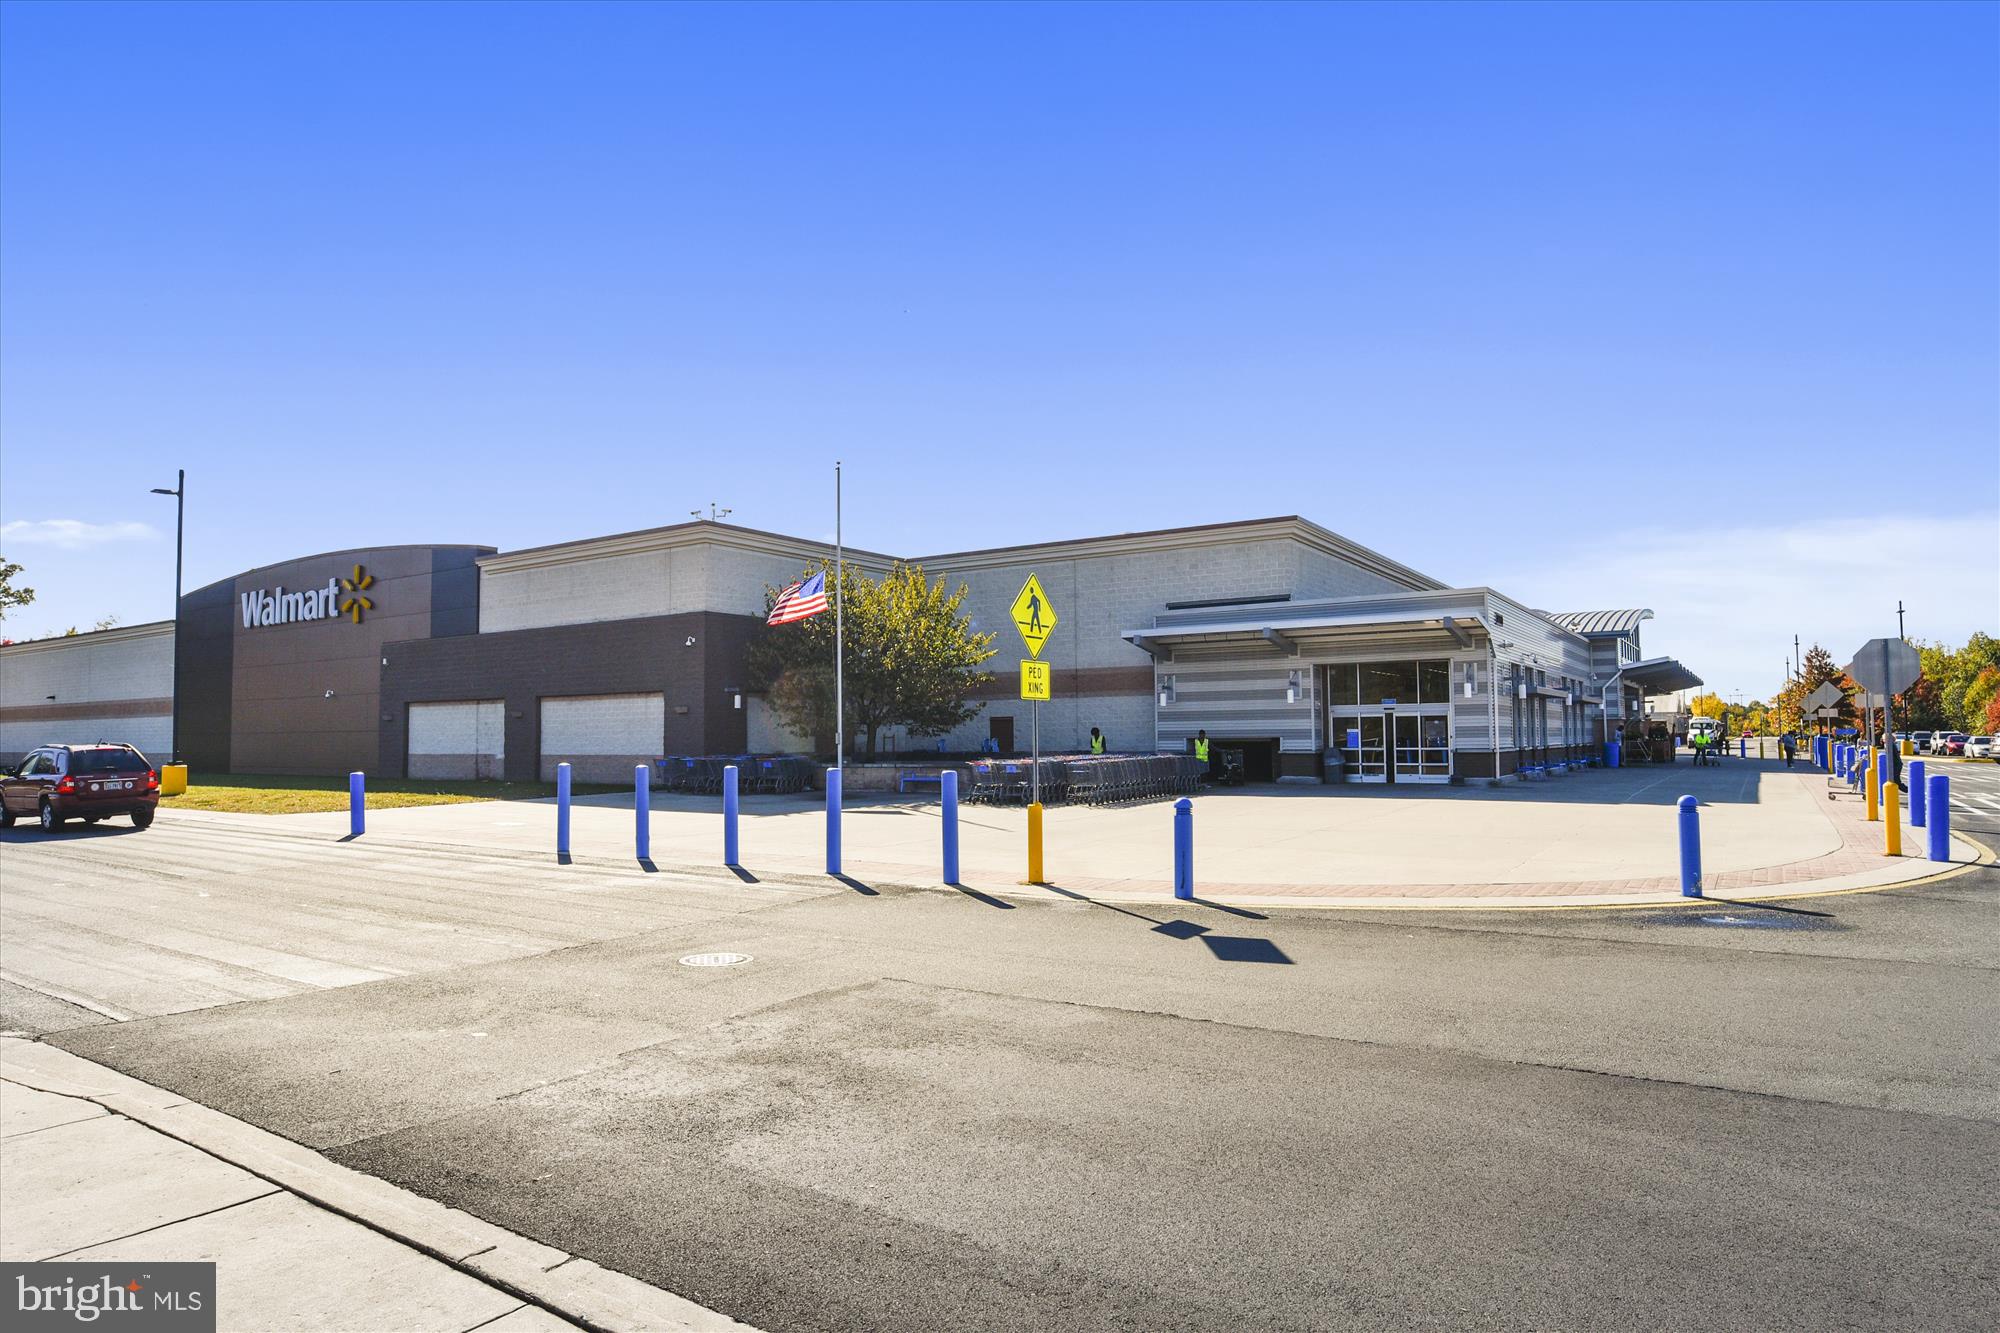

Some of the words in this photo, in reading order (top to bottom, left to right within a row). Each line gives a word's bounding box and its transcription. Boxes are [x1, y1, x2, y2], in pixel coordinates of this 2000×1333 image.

[241, 578, 340, 628] Walmart
[1028, 667, 1042, 679] PED
[1028, 682, 1044, 694] XING
